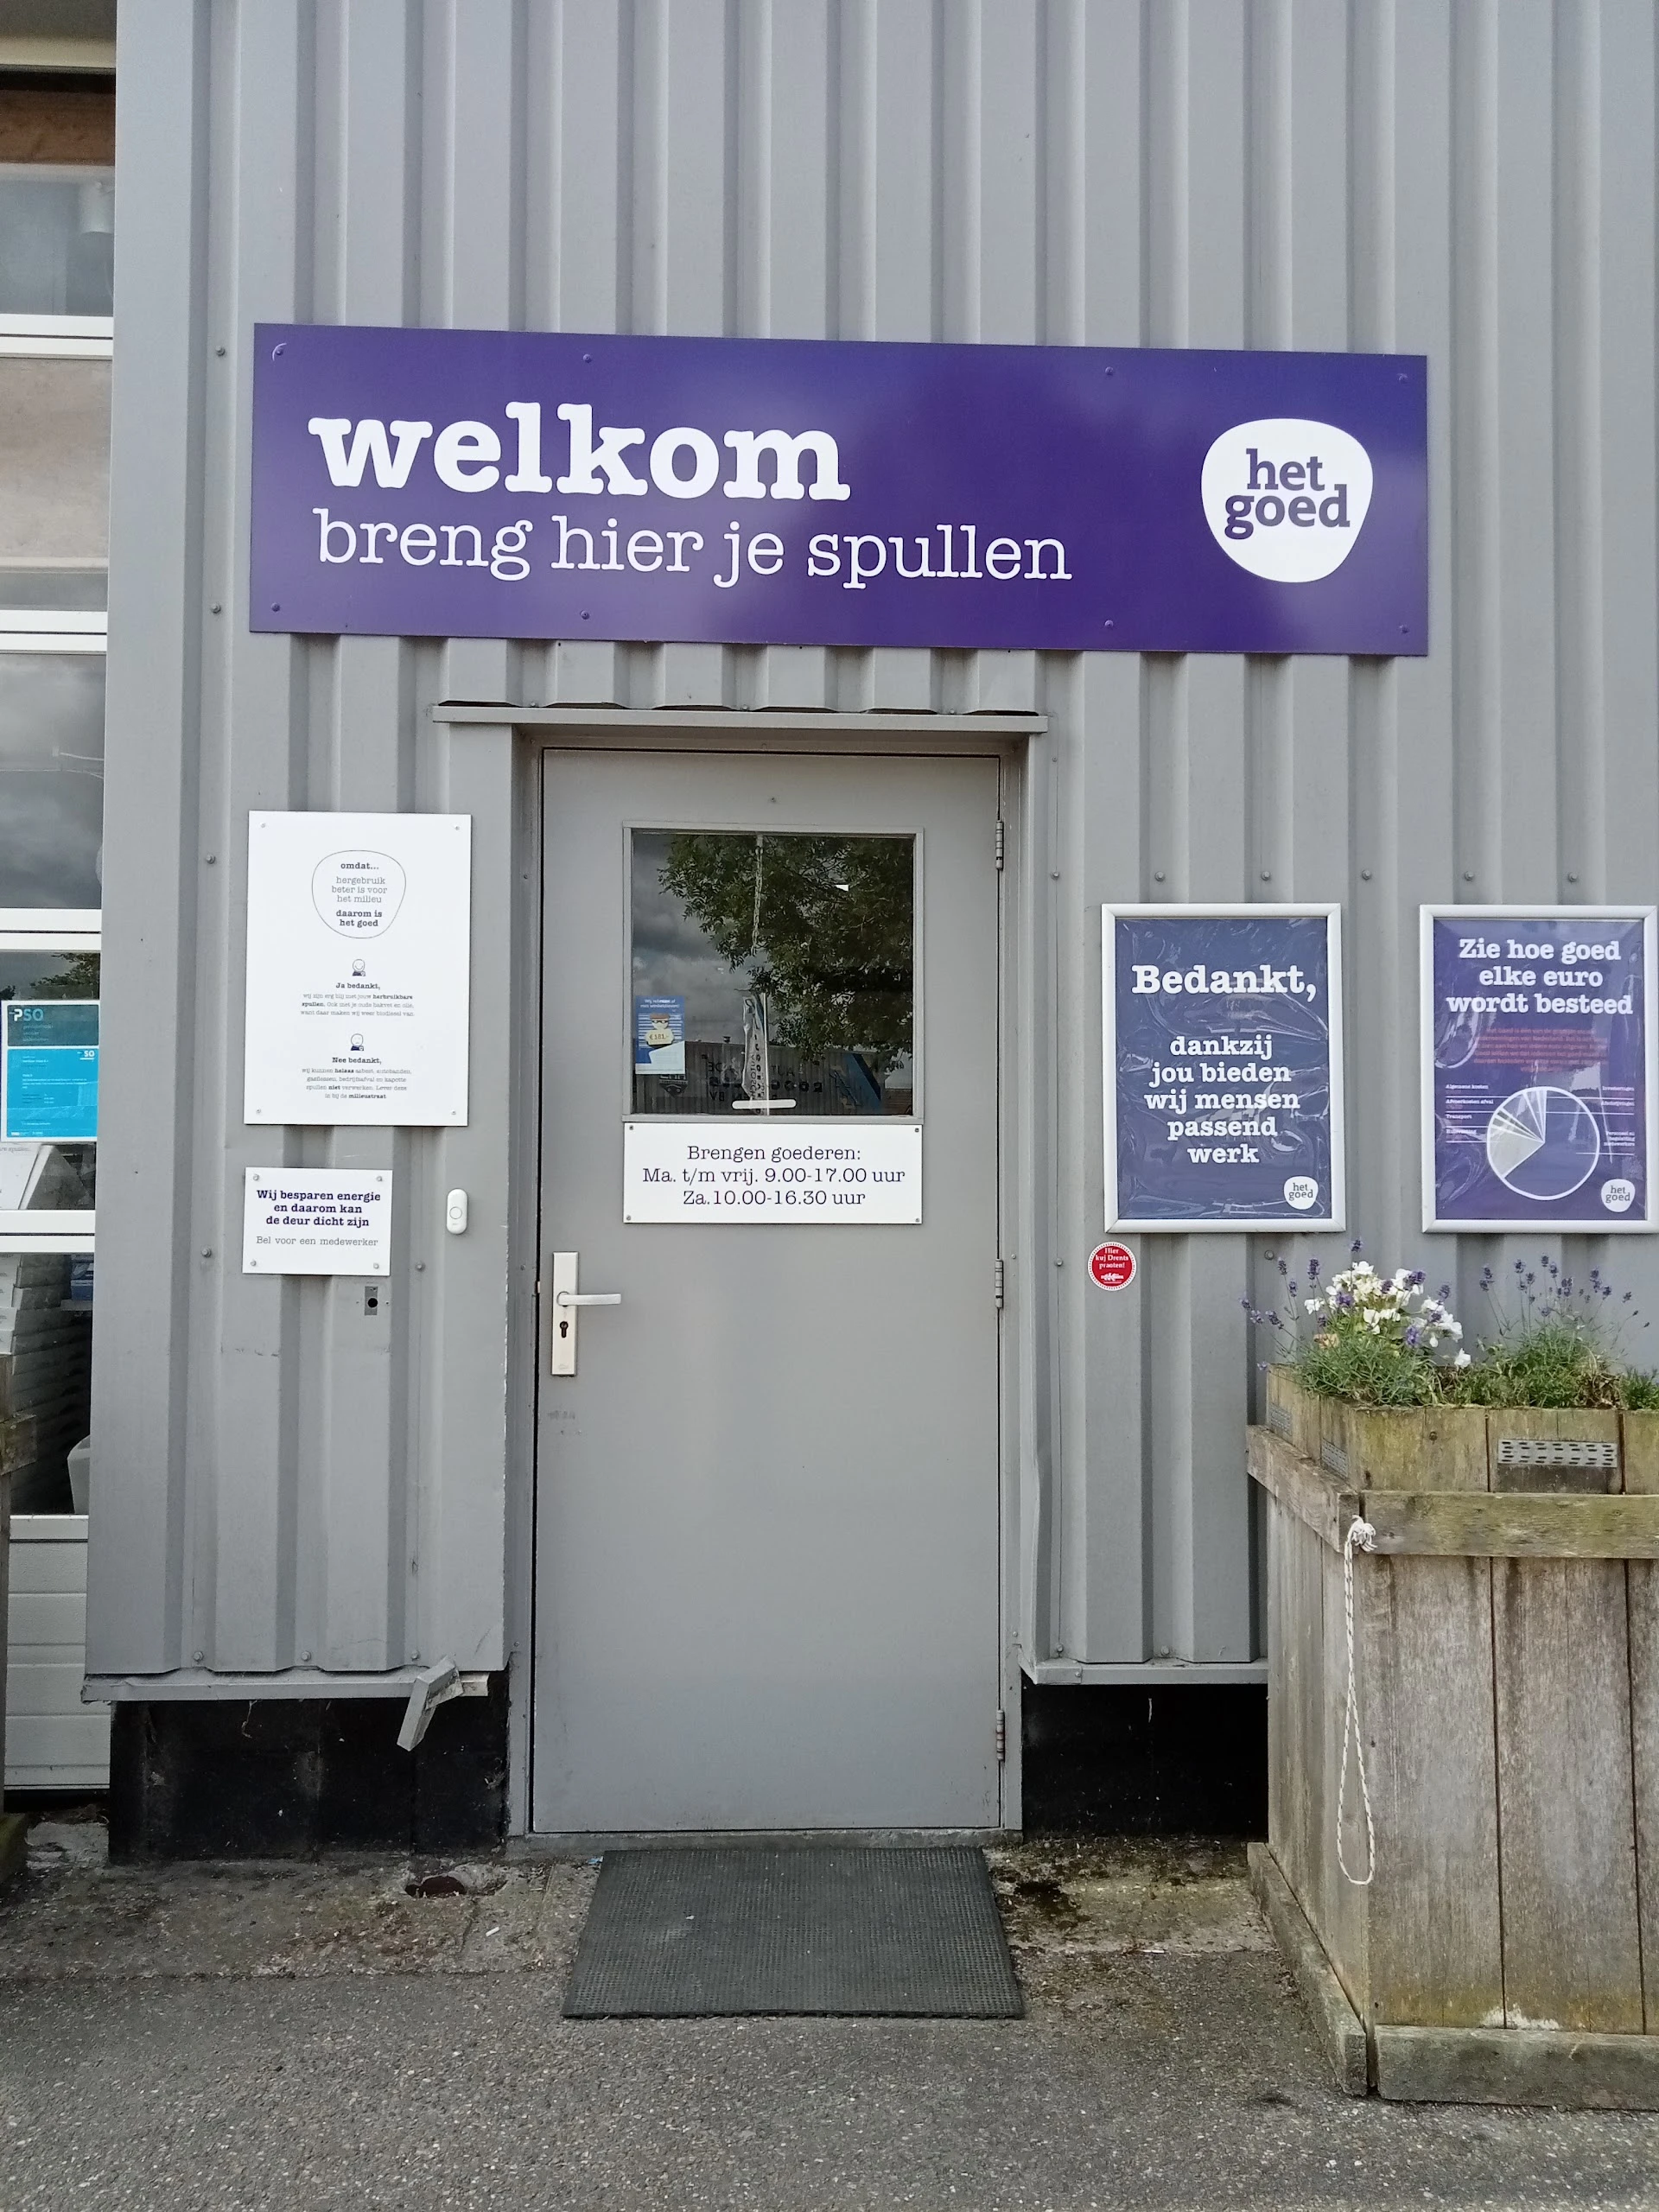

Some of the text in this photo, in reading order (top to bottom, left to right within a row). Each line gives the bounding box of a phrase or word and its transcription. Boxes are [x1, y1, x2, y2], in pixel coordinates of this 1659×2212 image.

[308, 402, 850, 500] welkom
[1246, 448, 1325, 491] het
[1224, 482, 1350, 539] goed
[313, 508, 1071, 589] breng hier je spullen
[340, 861, 379, 870] omdat...
[331, 885, 356, 893] beter
[357, 886, 365, 894] is
[335, 875, 385, 886] hergebruik
[336, 894, 382, 904] het milieu
[335, 909, 372, 918] daarom
[357, 919, 378, 929] goed
[1459, 938, 1621, 964] Zie hoe goed
[1132, 965, 1315, 1001] Bedankt,
[1480, 966, 1603, 986] elke euro
[1446, 994, 1632, 1014] wordt besteed
[1171, 1035, 1271, 1059] dankzij
[347, 1057, 382, 1065] bedankt,
[1150, 1062, 1293, 1088] jou bieden
[1144, 1090, 1300, 1114] wij mensen
[1167, 1117, 1277, 1140] passend
[688, 1145, 861, 1163] Brengen goederen:
[1187, 1144, 1259, 1163] werk
[642, 1167, 906, 1186] Ma. t/m vrij. 9.00-17.00 uur
[256, 1189, 381, 1204] Wij besparen energie
[683, 1190, 866, 1205] Za.10.00-16.30 uur
[1288, 1190, 1313, 1201] goed
[1606, 1192, 1632, 1204] goed
[290, 1203, 337, 1213] daarom
[339, 1204, 363, 1214] kan
[265, 1216, 369, 1229] de deur dicht zijn
[256, 1236, 271, 1244] Bel
[319, 1237, 378, 1246] medewerker
